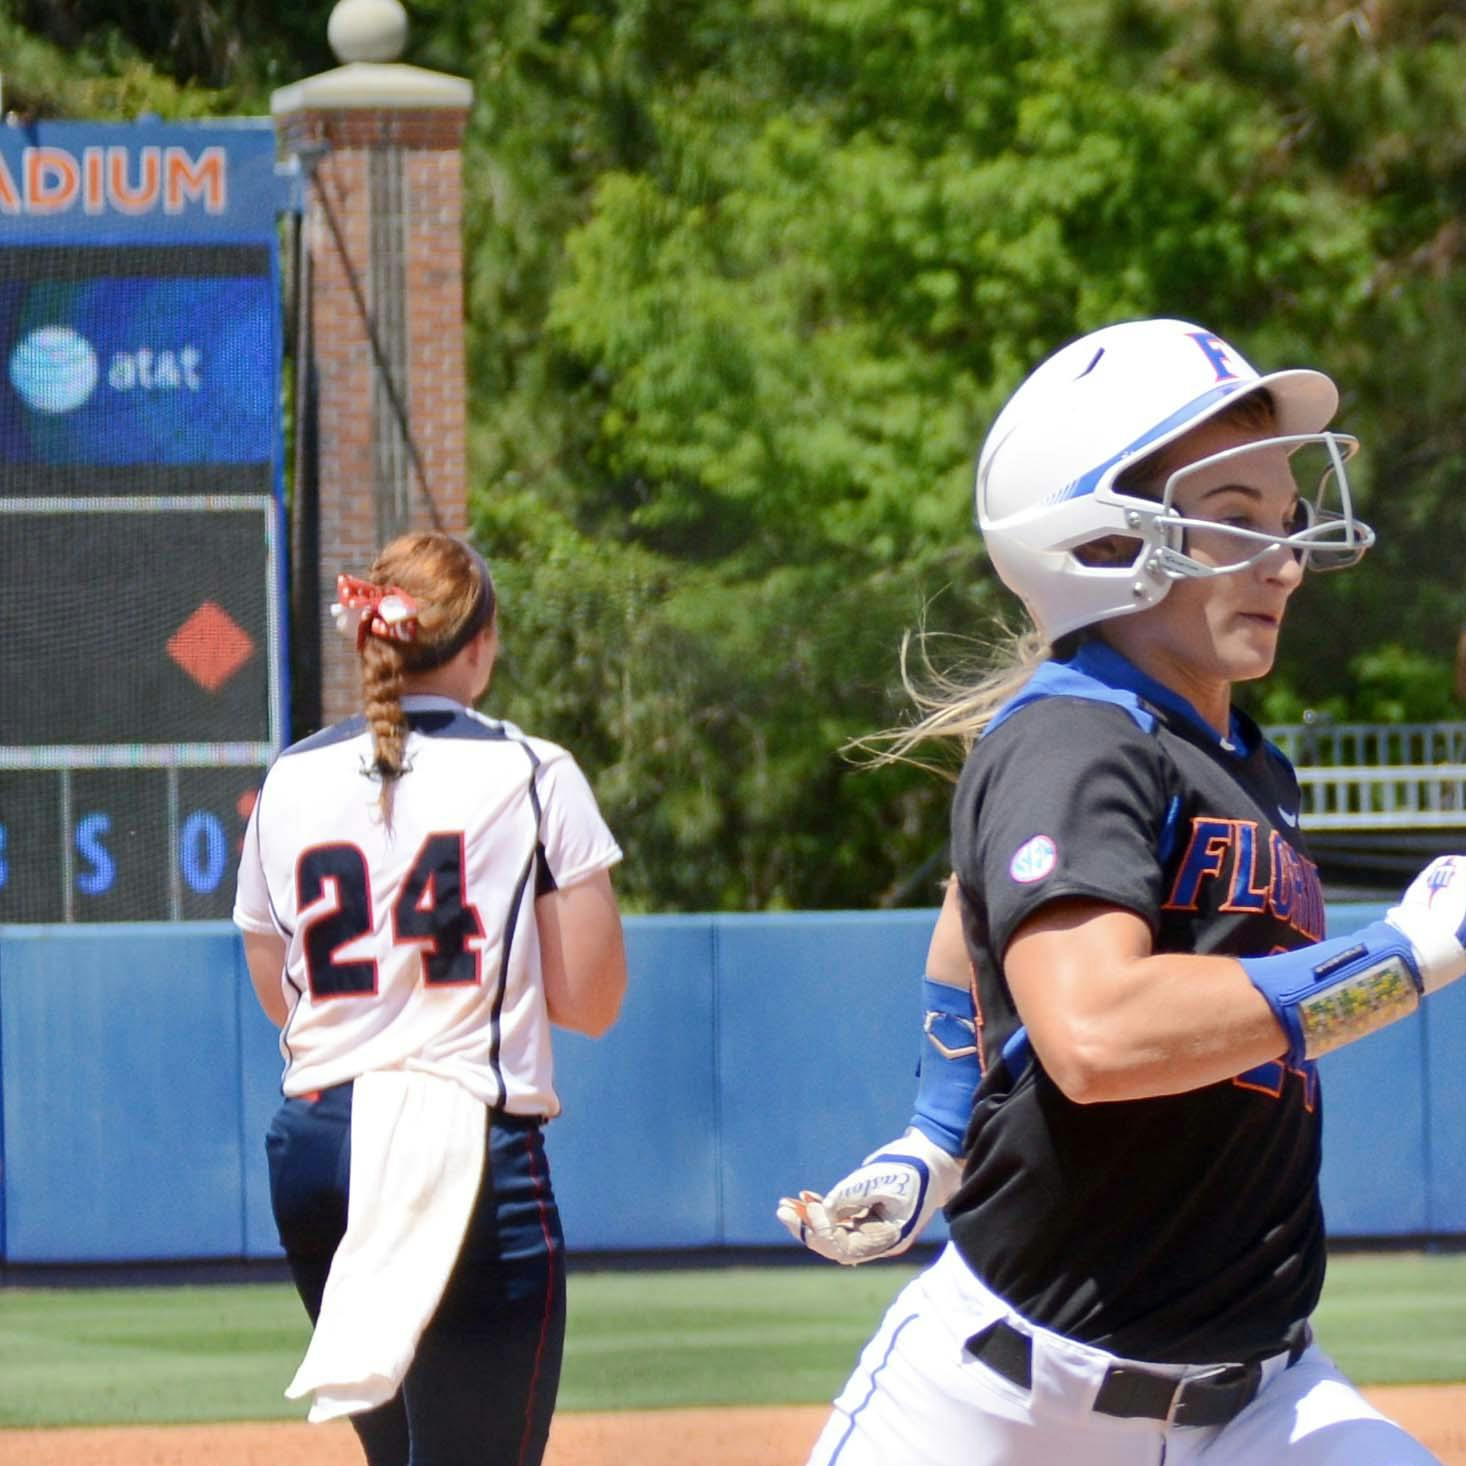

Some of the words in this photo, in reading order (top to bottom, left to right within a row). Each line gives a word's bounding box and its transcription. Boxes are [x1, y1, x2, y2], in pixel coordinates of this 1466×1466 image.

[1184, 332, 1240, 383] F
[75, 812, 117, 895] S
[295, 829, 487, 1001] 24
